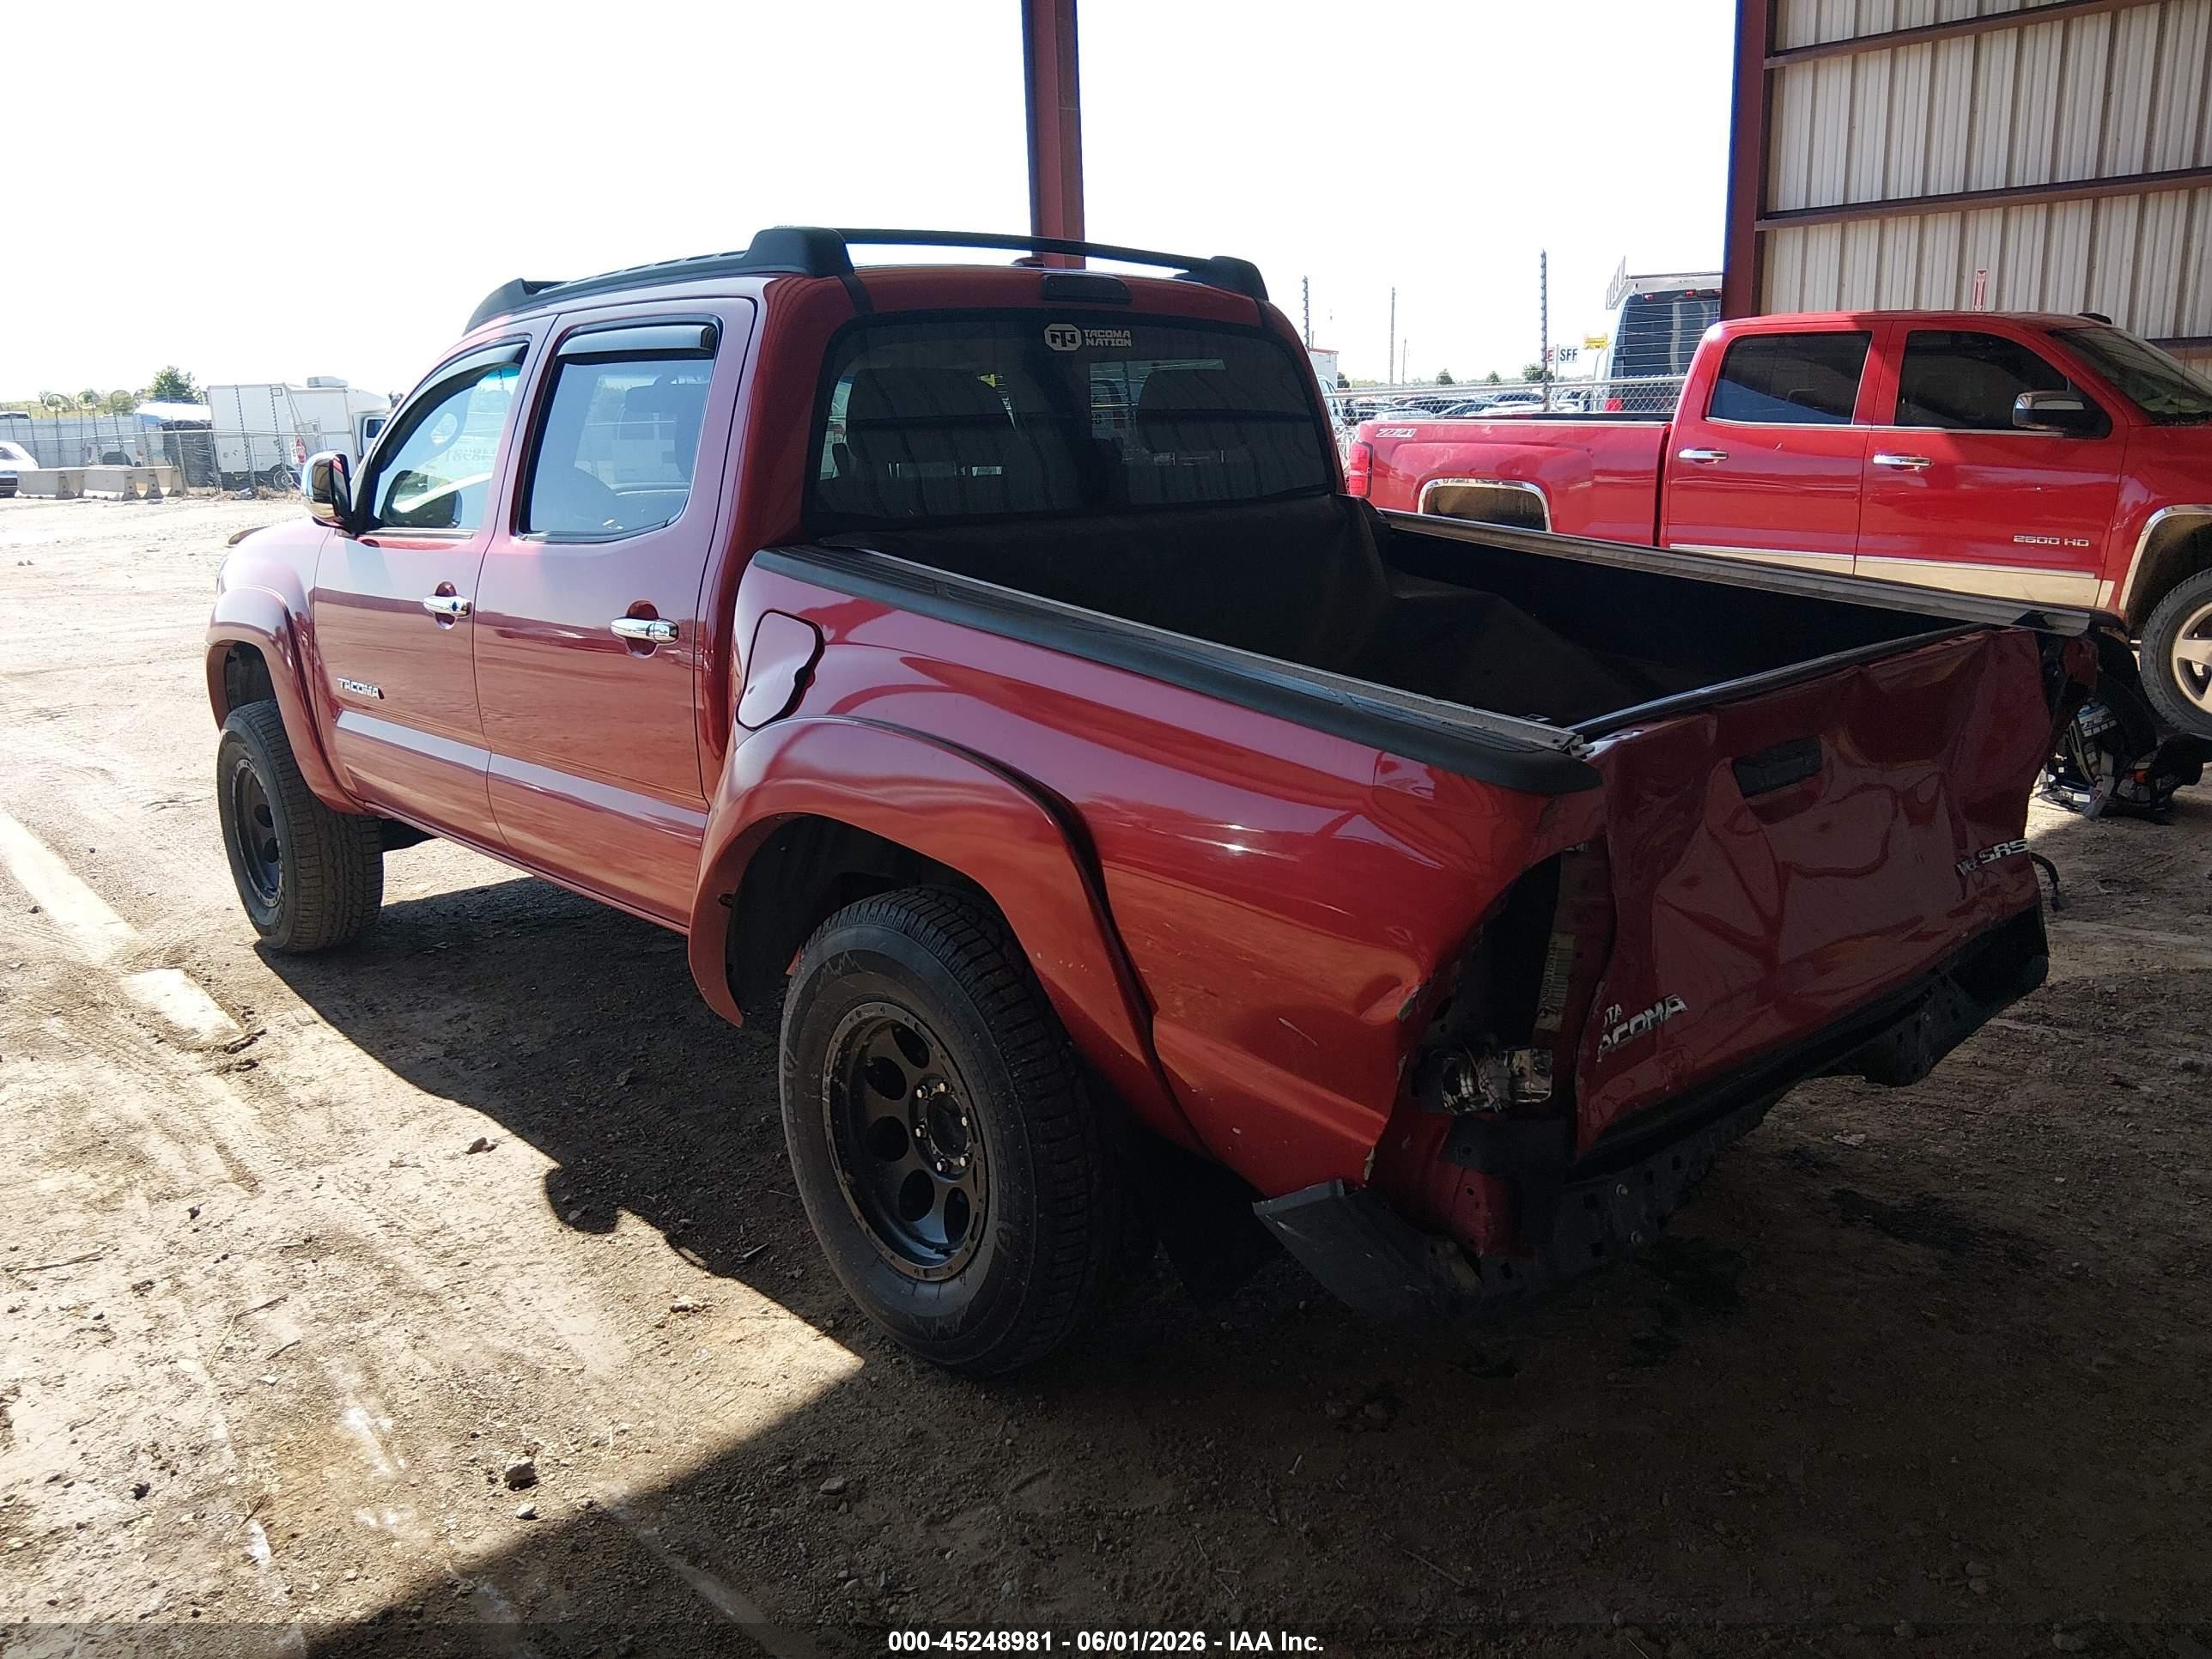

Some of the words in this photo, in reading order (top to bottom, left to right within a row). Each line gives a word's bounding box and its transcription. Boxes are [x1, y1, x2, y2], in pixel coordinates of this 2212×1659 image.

[1084, 330, 1131, 338] TACOMA
[1085, 338, 1132, 347] NATION
[1559, 349, 1577, 362] SFF
[2013, 535, 2060, 545] 2500
[2063, 538, 2089, 547] HD
[337, 678, 380, 699] TACOMA
